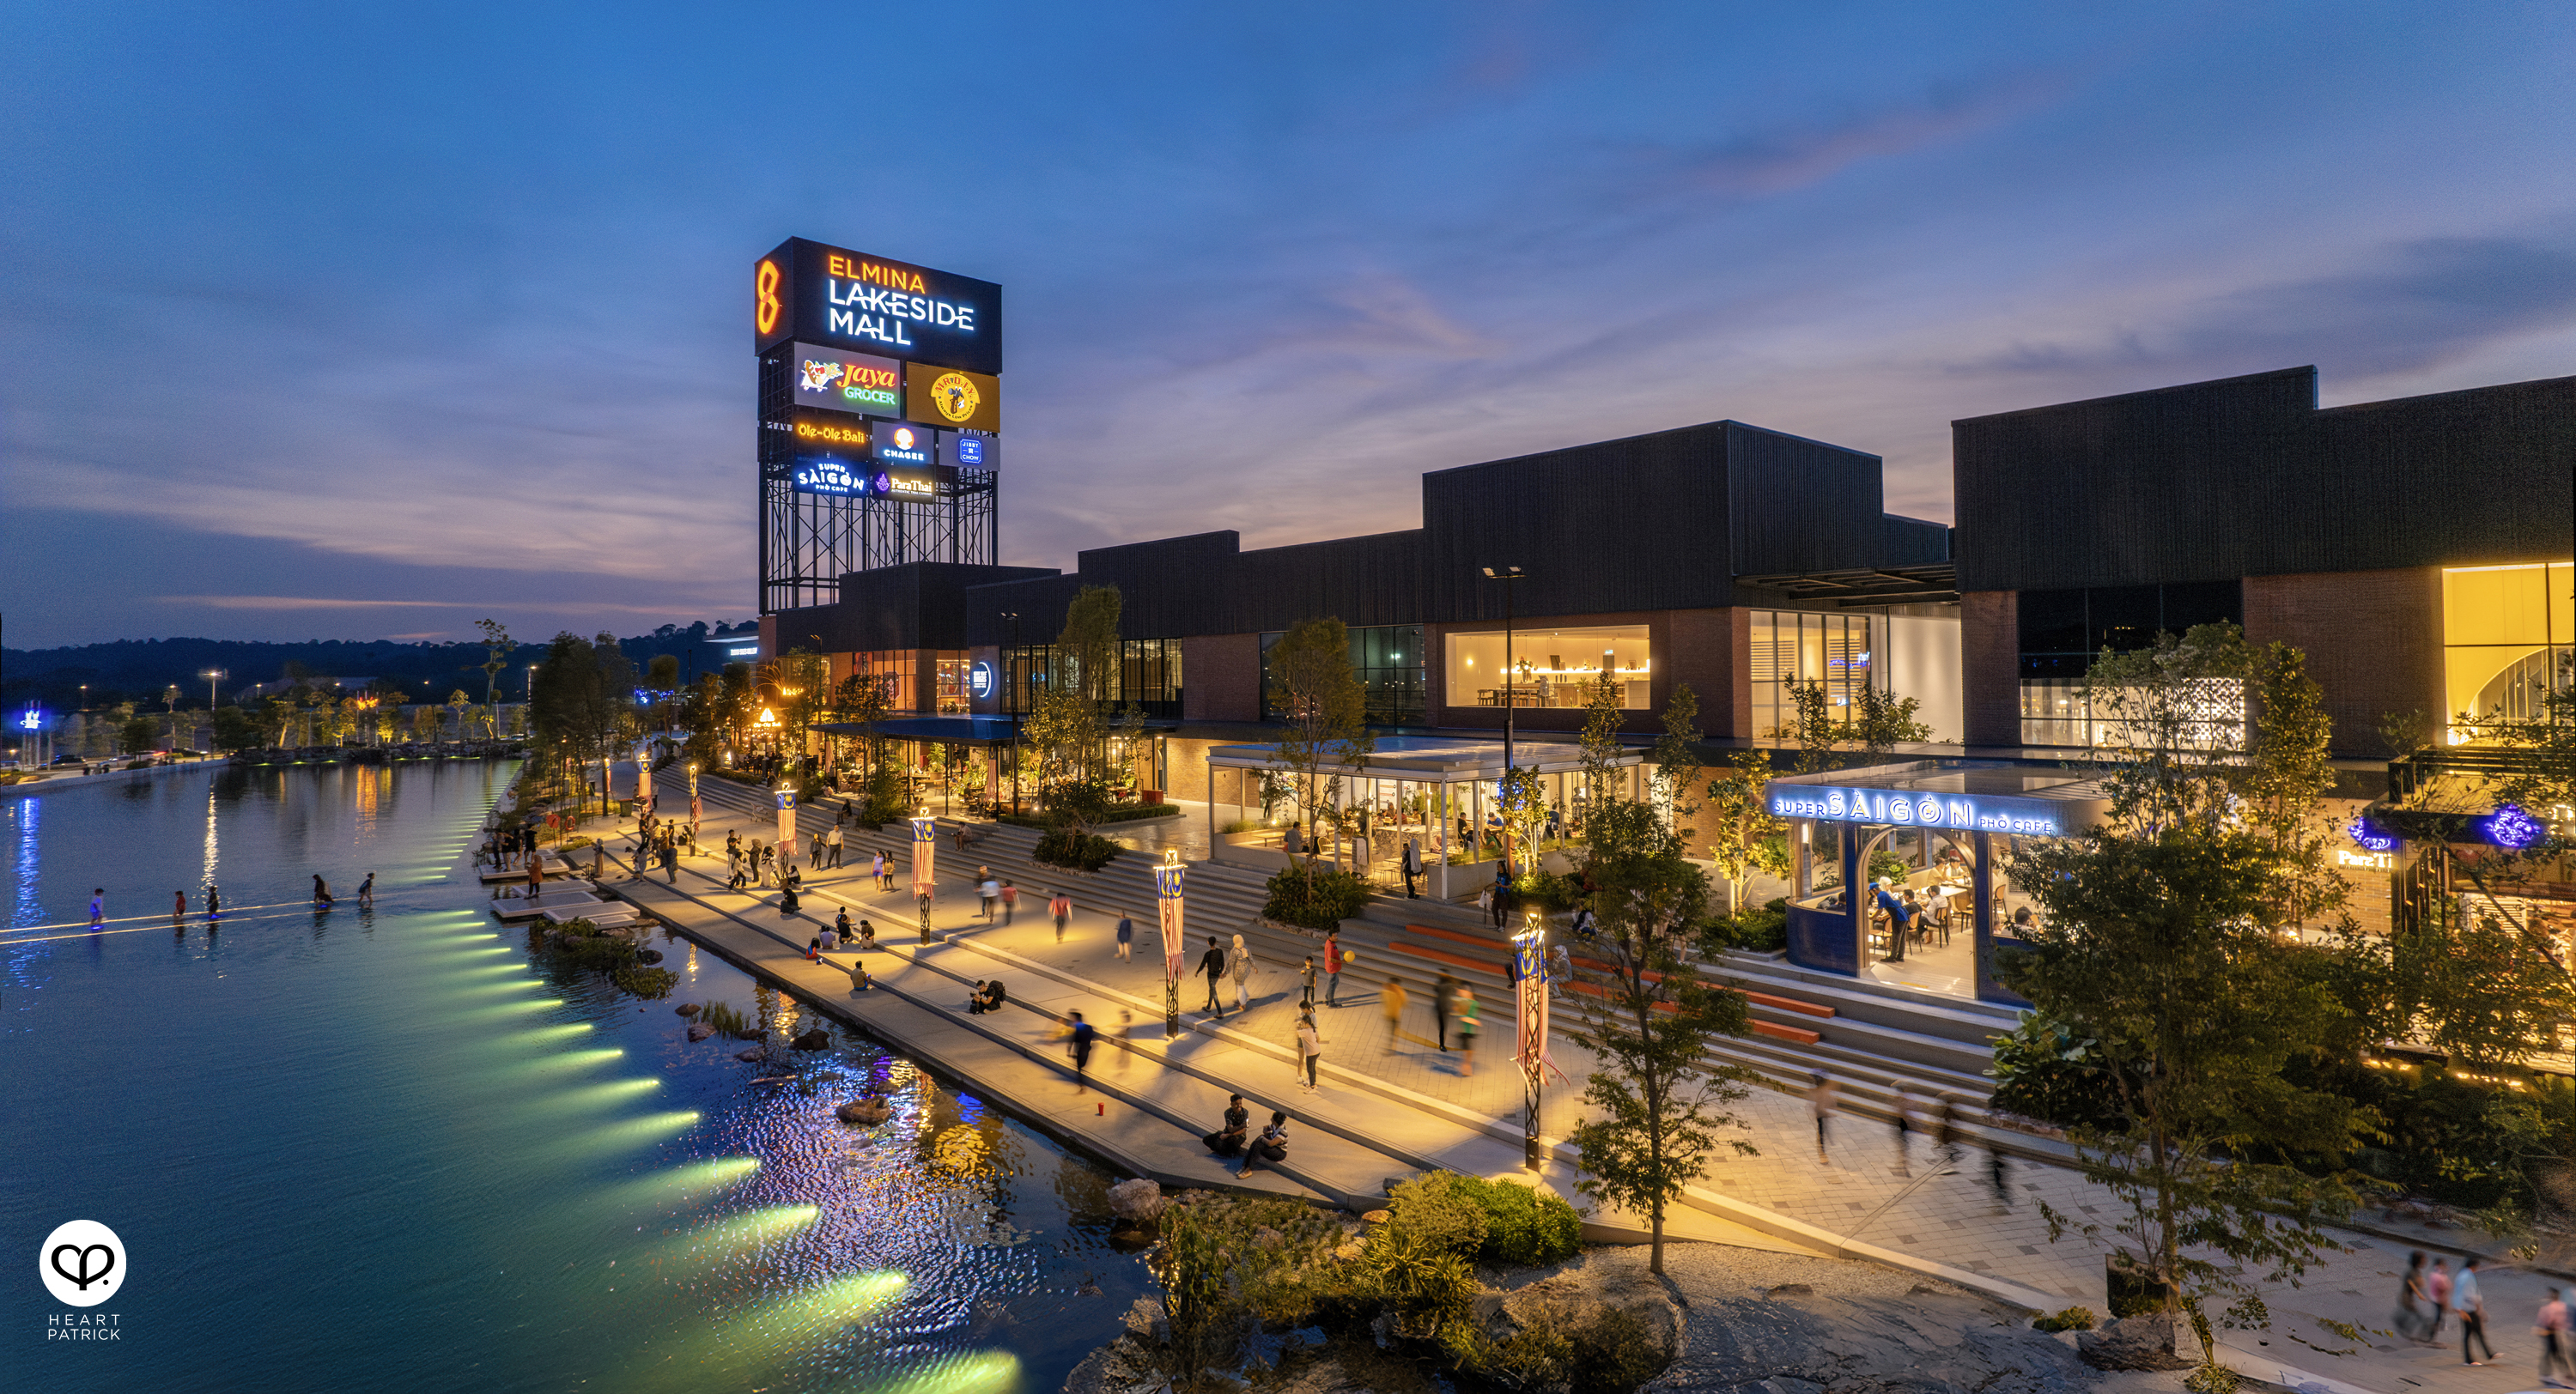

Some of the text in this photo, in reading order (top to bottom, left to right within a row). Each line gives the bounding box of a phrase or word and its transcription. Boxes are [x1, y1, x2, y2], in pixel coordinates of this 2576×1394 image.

[829, 255, 926, 294] ELMINA
[829, 279, 975, 330] LAKESIDE
[829, 307, 911, 345] MALL
[837, 364, 896, 389] Jaya
[844, 386, 896, 405] GROCER
[842, 429, 864, 443] Bali
[884, 449, 924, 461] CHAGEE
[818, 464, 846, 473] SUPER
[890, 477, 932, 492] ParaThai
[1775, 801, 1825, 815] SUPER
[2013, 821, 2051, 832] CAFE
